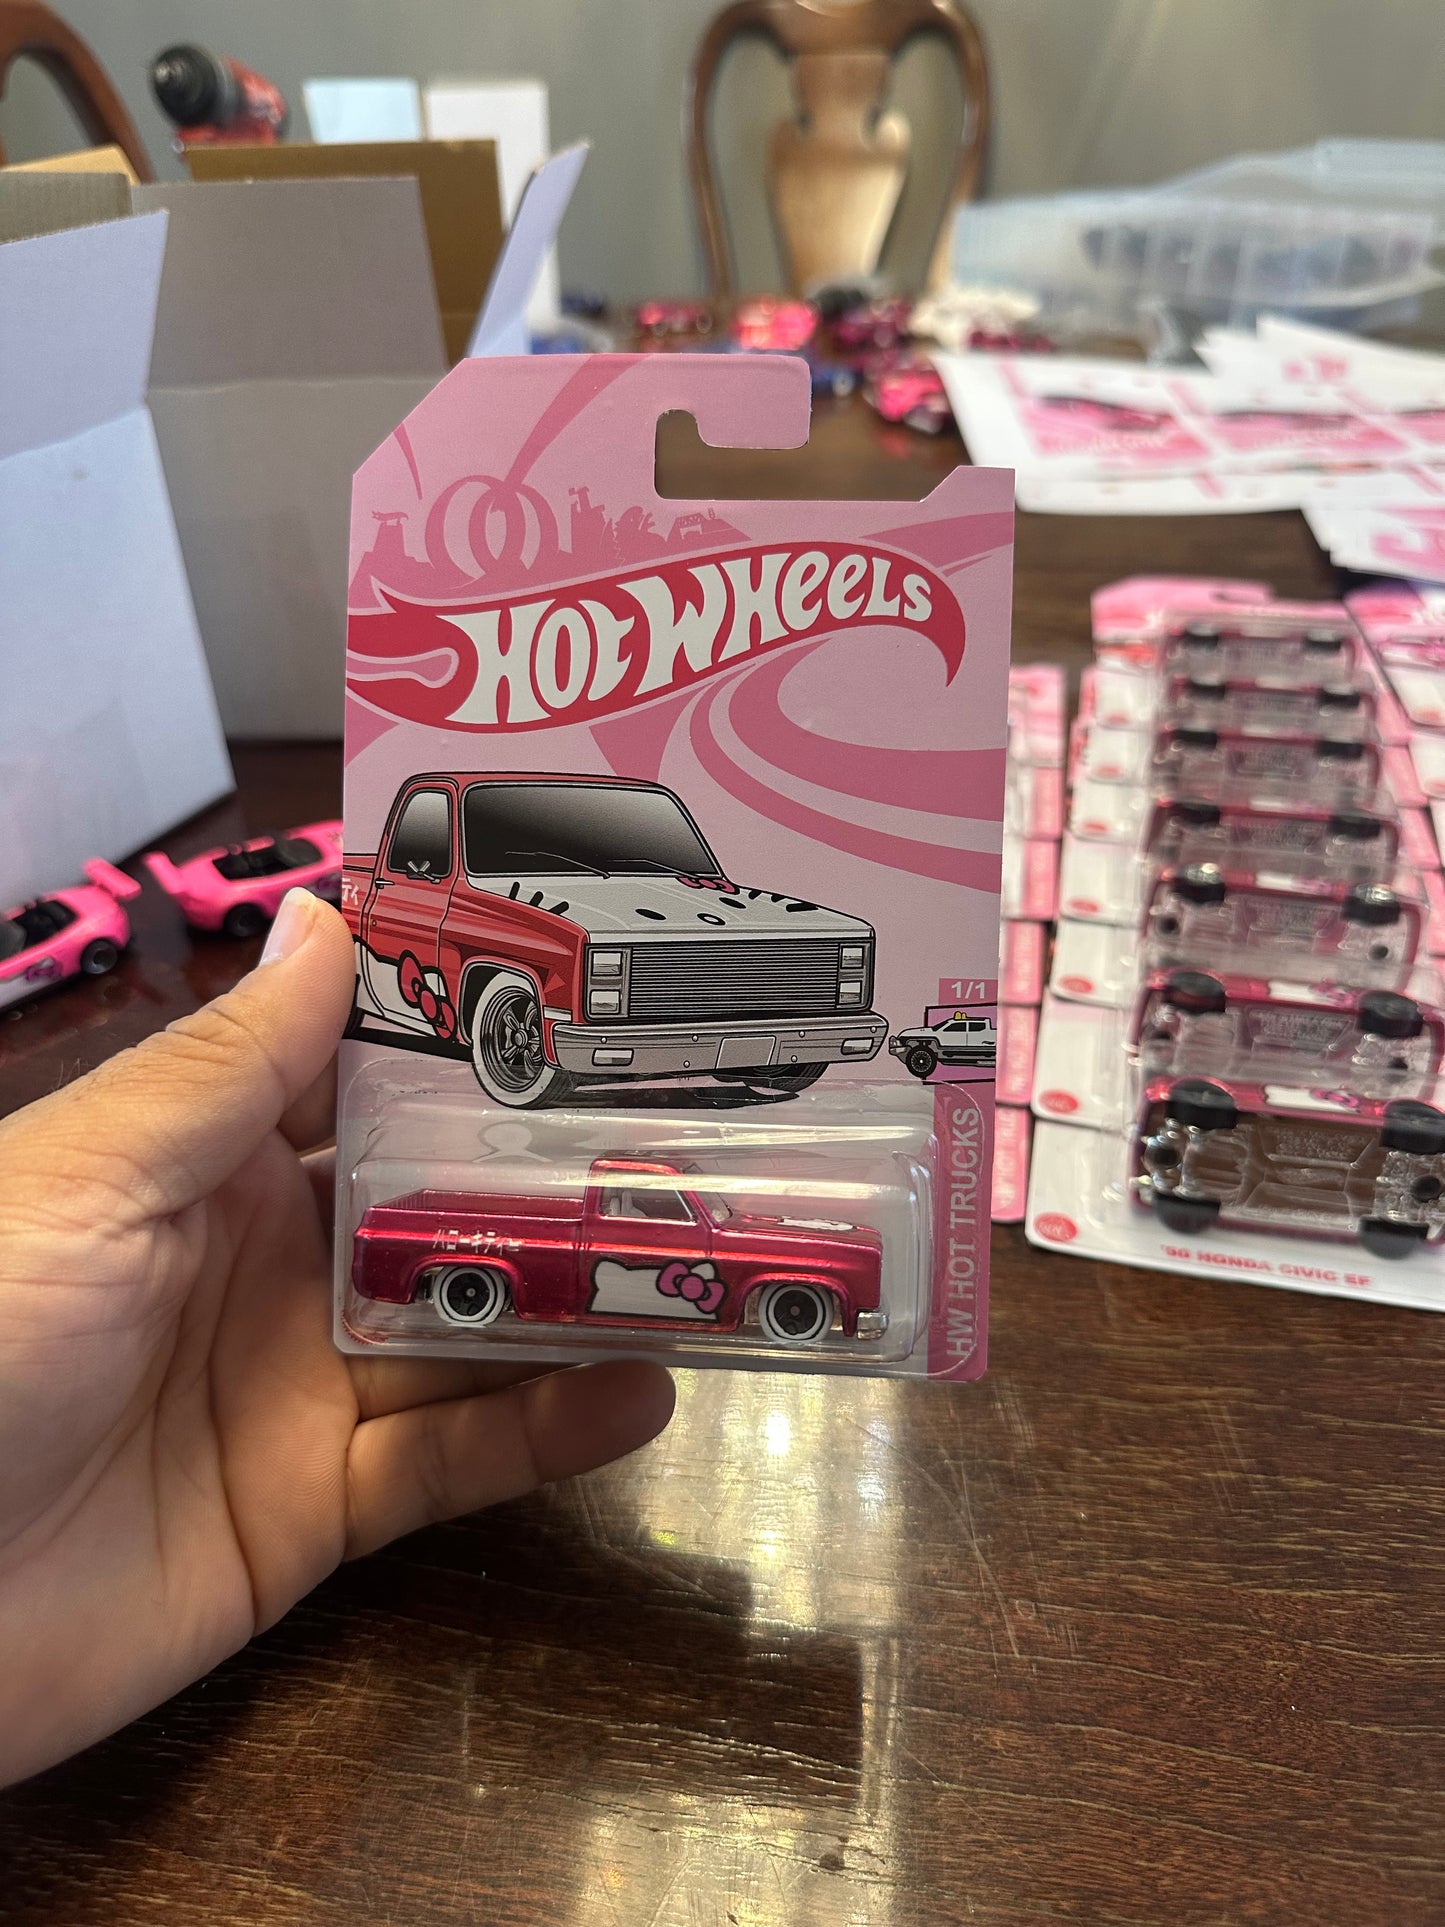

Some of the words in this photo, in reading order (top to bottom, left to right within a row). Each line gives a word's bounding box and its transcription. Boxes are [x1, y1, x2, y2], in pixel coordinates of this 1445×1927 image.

[951, 981, 985, 999] 1/1
[950, 1107, 980, 1231] TRUCKS
[948, 1236, 976, 1300] HOT
[1196, 1250, 1272, 1272] HONDA
[1278, 1262, 1338, 1282] CIVIC
[1344, 1273, 1373, 1286] EF
[946, 1306, 974, 1357] HW
